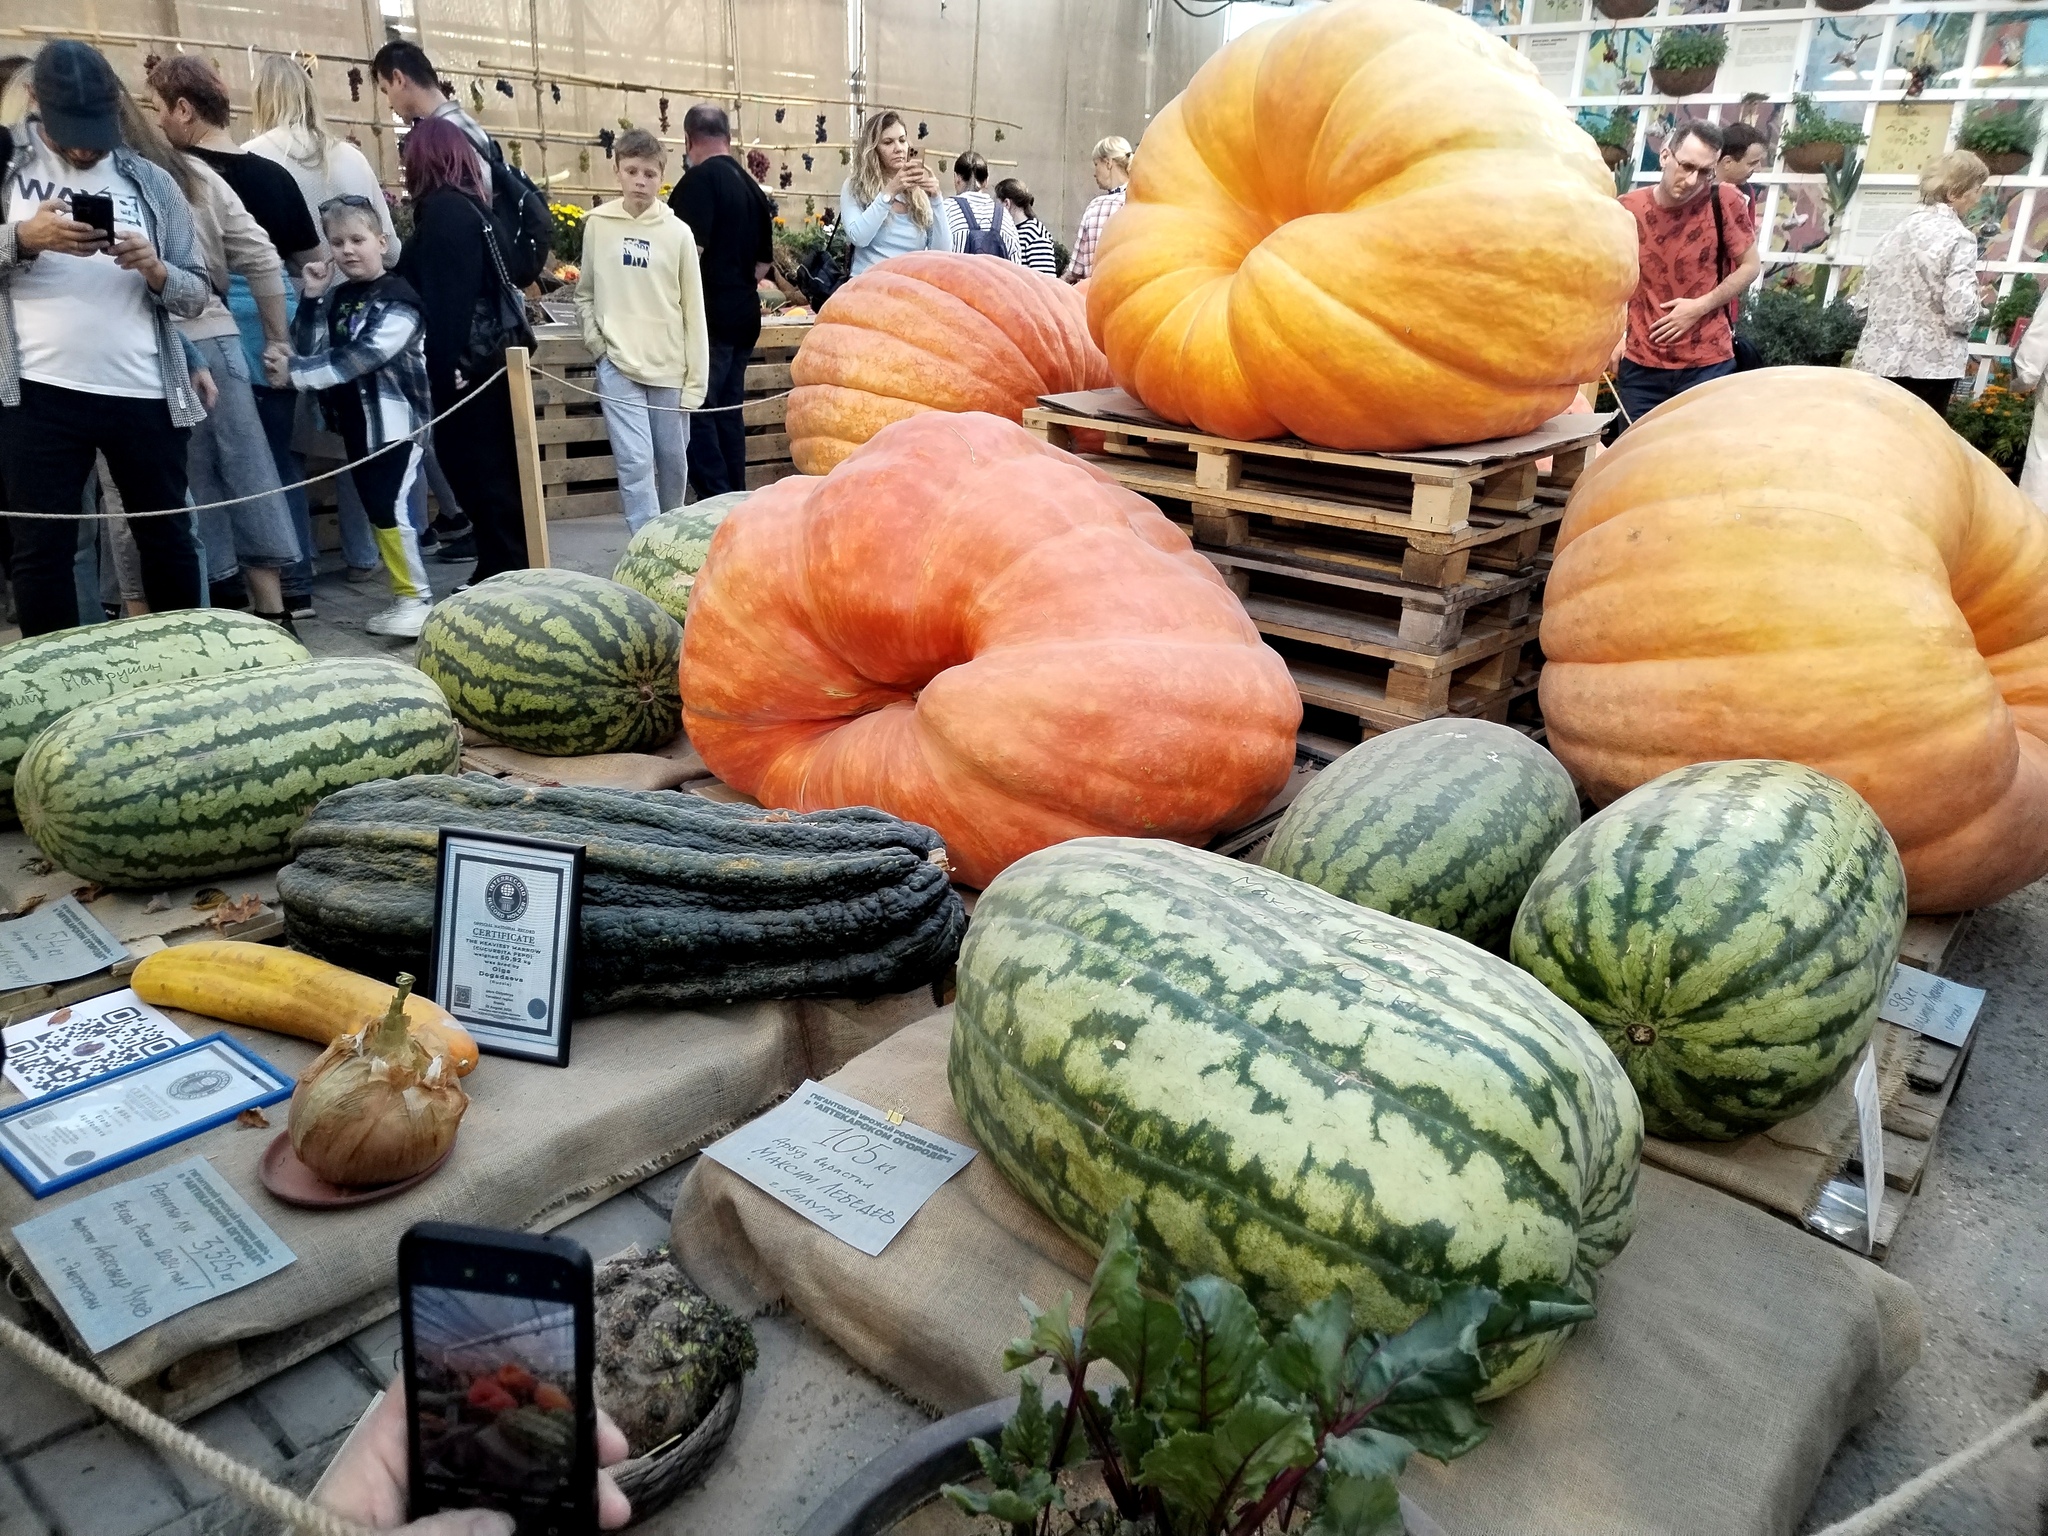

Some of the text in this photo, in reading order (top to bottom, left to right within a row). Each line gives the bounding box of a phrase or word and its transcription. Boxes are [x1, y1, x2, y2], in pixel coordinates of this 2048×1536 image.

[489, 874, 527, 897] INTERRECORD
[472, 927, 535, 944] CERTIFICATE
[478, 970, 523, 982] Dogadaeva
[1888, 992, 1914, 1011] 98
[809, 1092, 858, 1116] ГИГАНТСКИЙ
[858, 1113, 894, 1131] УРОЖАЙ
[893, 1129, 926, 1145] РОССИИ
[926, 1142, 948, 1154] 2024
[772, 1138, 807, 1158] Арбуз
[813, 1128, 891, 1164] 105
[191, 1235, 243, 1276] 3,325
